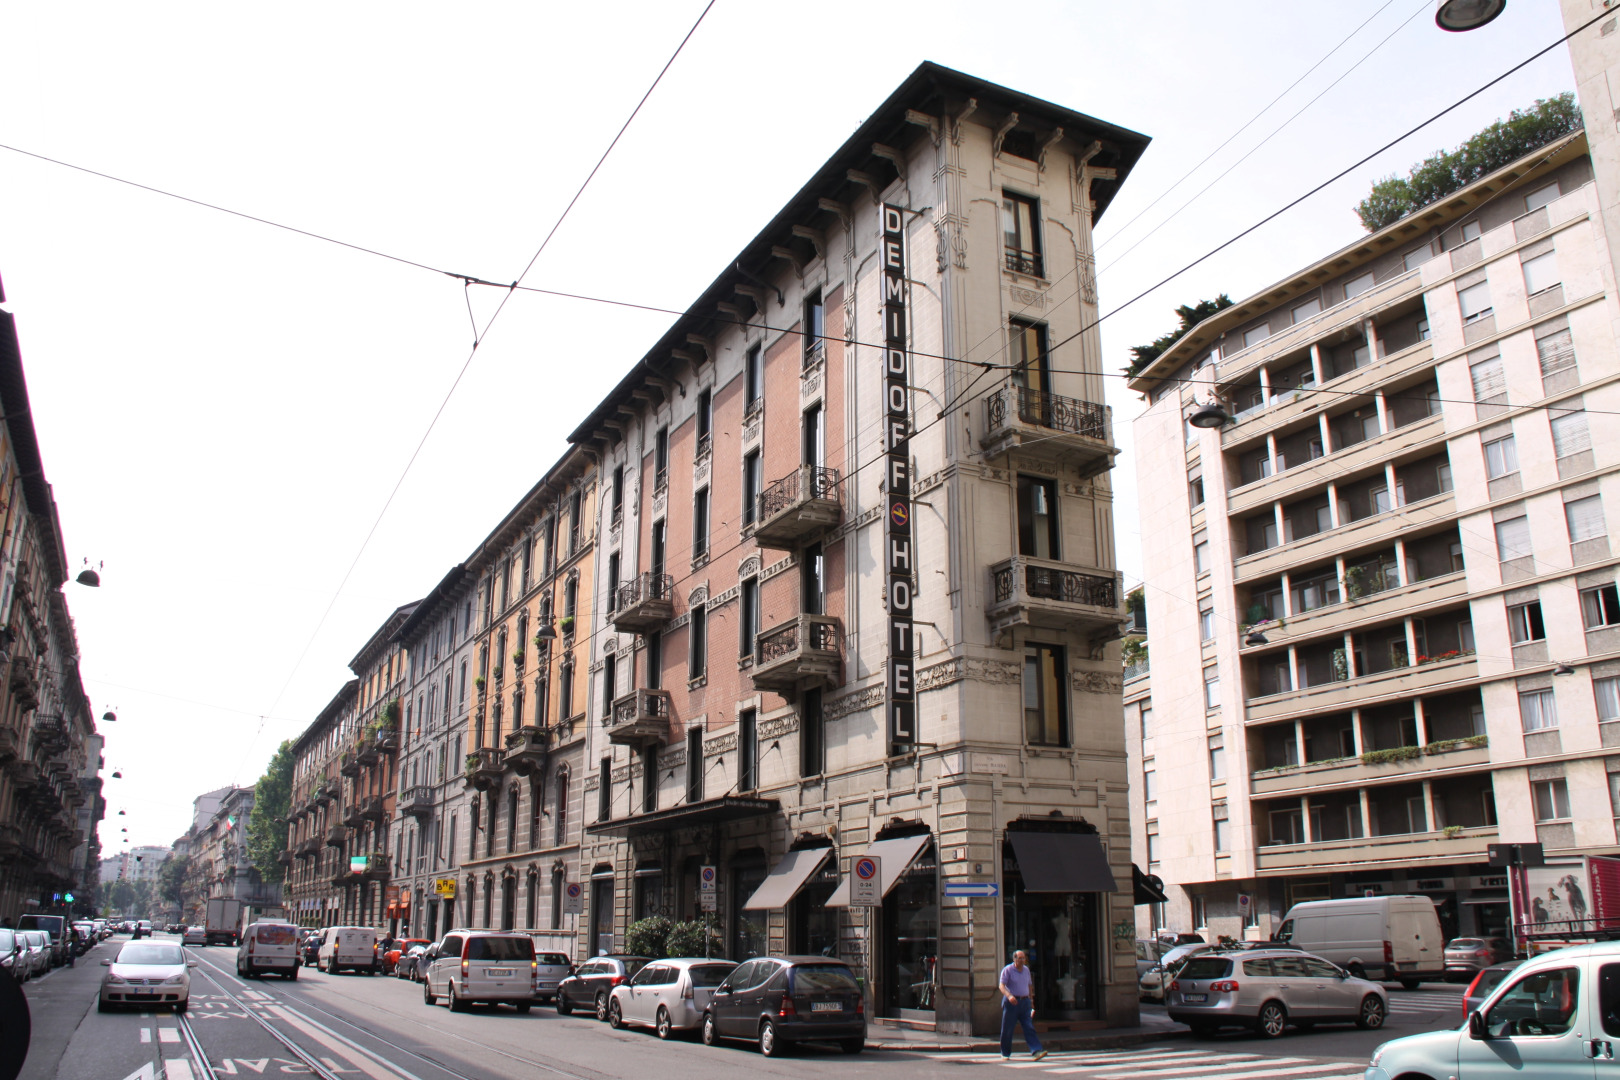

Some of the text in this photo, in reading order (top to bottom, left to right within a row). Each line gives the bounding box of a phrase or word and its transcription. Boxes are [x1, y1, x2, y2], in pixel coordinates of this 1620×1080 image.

[885, 207, 910, 737] DEMIDOFF HOTEL
[436, 880, 454, 891] BAR
